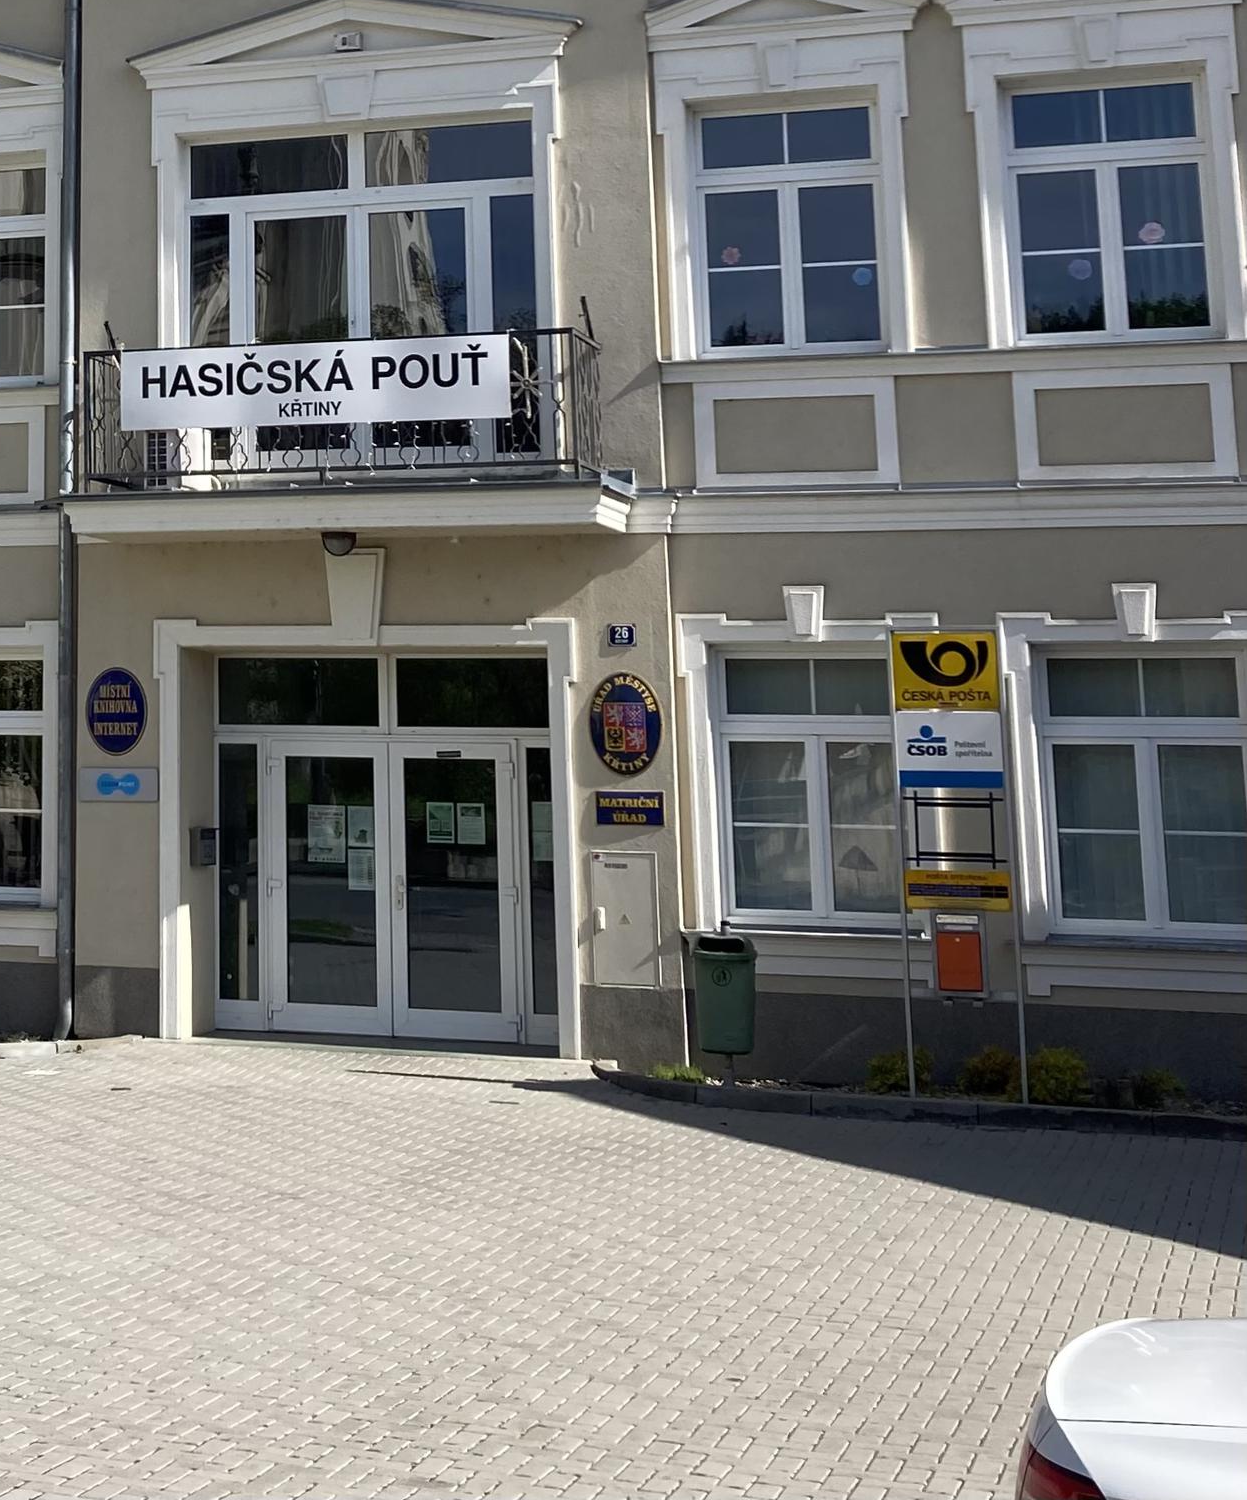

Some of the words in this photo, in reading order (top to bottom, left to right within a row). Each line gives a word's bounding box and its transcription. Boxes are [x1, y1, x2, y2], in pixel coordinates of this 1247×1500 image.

[141, 348, 354, 399] HASIČSKÁ
[371, 343, 489, 390] POUŤ
[278, 399, 342, 418] KŘTINY
[614, 626, 629, 639] 26
[99, 681, 131, 698] MÍSTNÍ
[901, 688, 945, 701] ČESKÁ
[949, 688, 991, 701] POŠTA
[93, 700, 138, 713] KNIHOVNA
[93, 722, 138, 736] INTERNET
[907, 744, 948, 756] ČSOB
[599, 796, 659, 808] MATRIČNÍ
[613, 810, 647, 822] ÚŘAD
